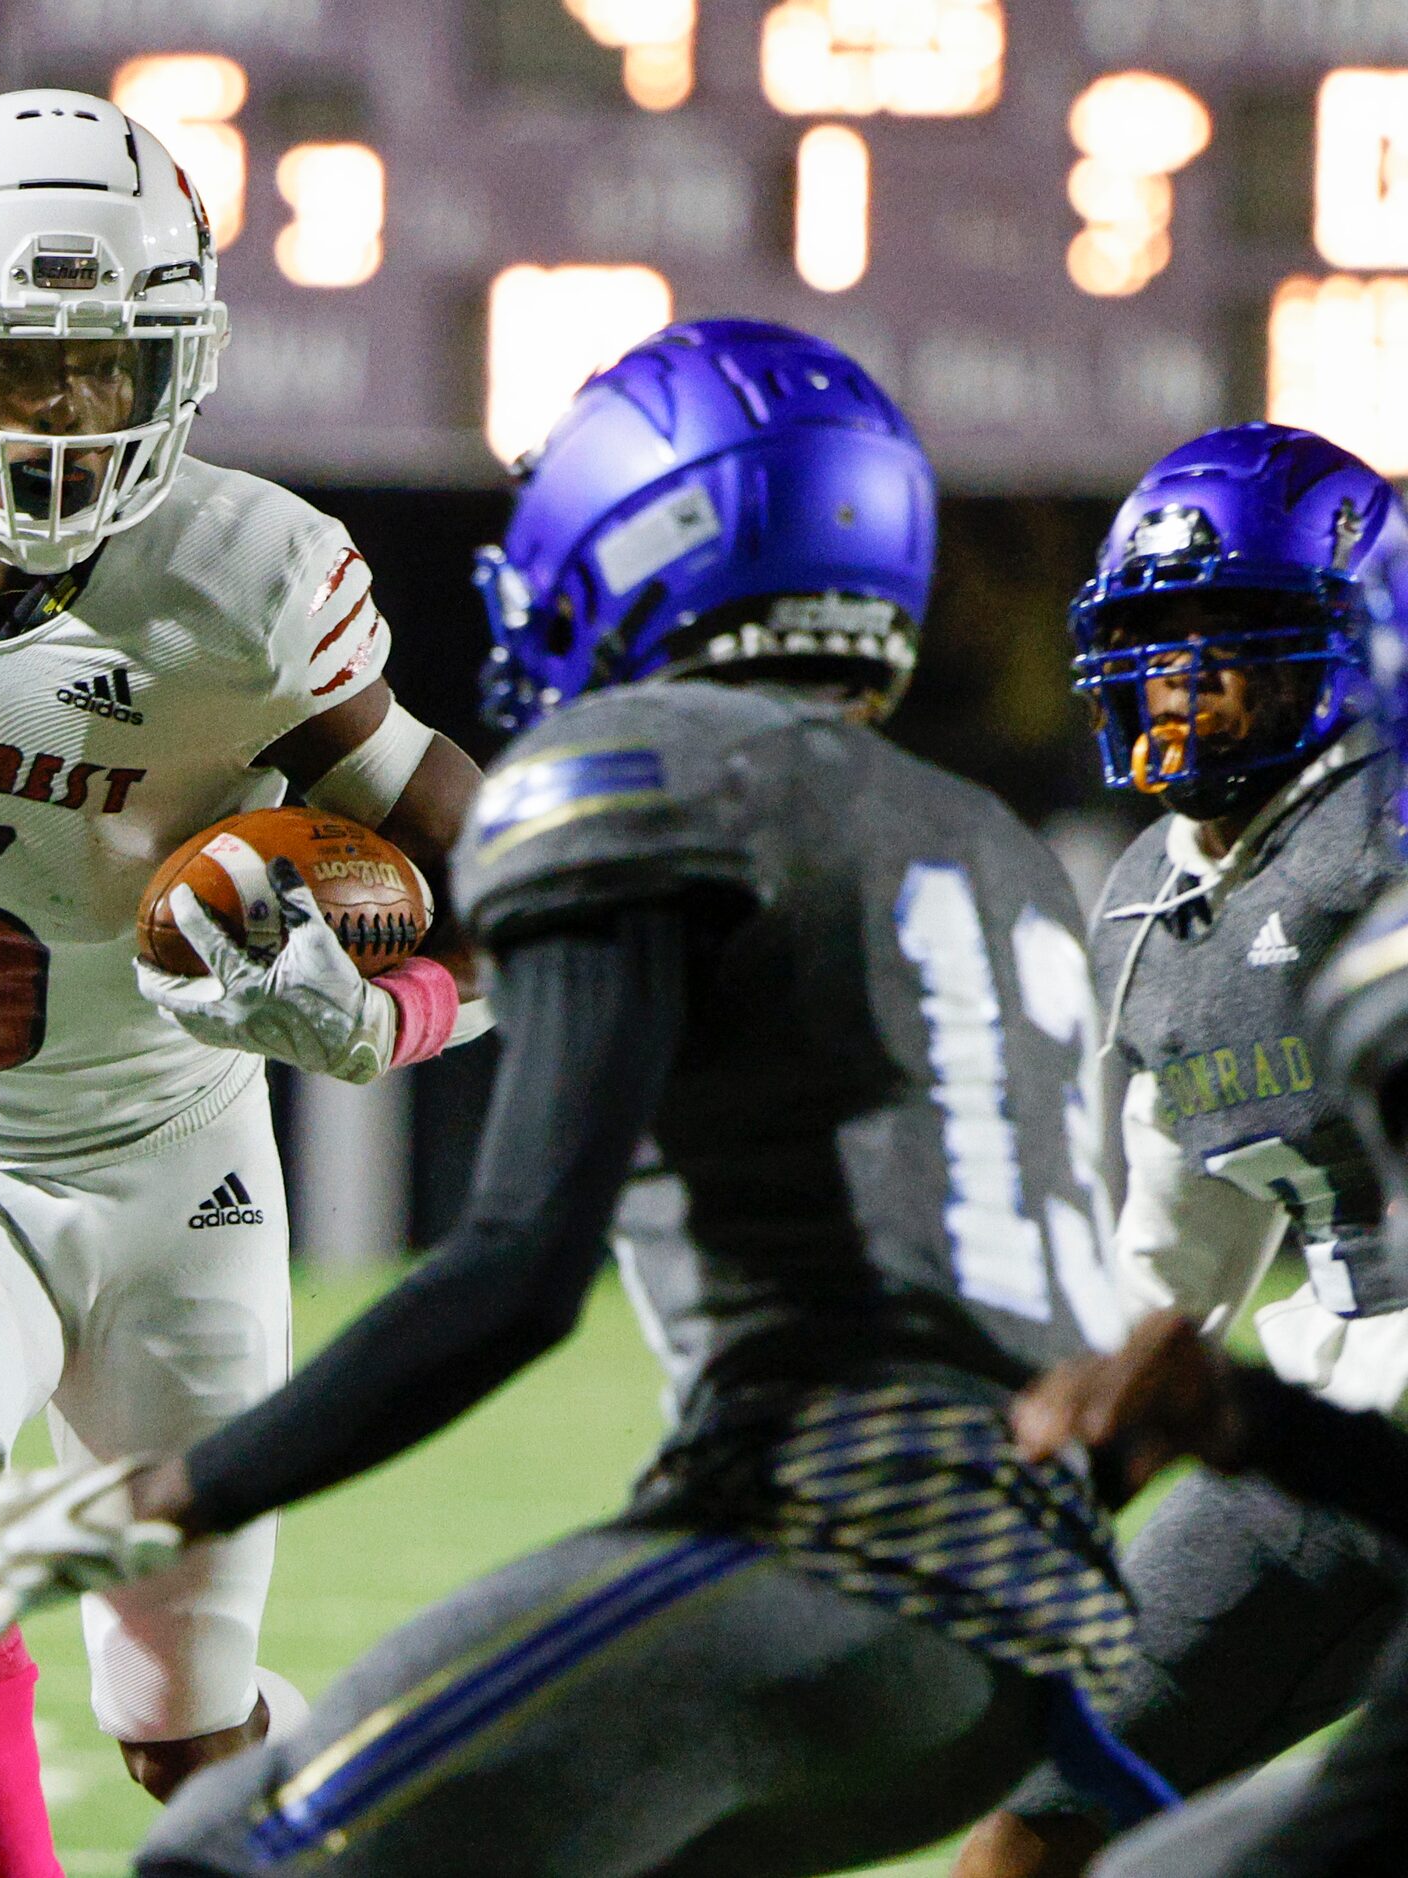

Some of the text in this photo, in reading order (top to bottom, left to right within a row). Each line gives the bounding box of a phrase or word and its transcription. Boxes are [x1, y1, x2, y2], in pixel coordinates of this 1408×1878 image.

[35, 264, 98, 281] schutt
[55, 688, 144, 726] adidas
[313, 860, 407, 893] Wilson
[188, 1206, 264, 1230] adidas
